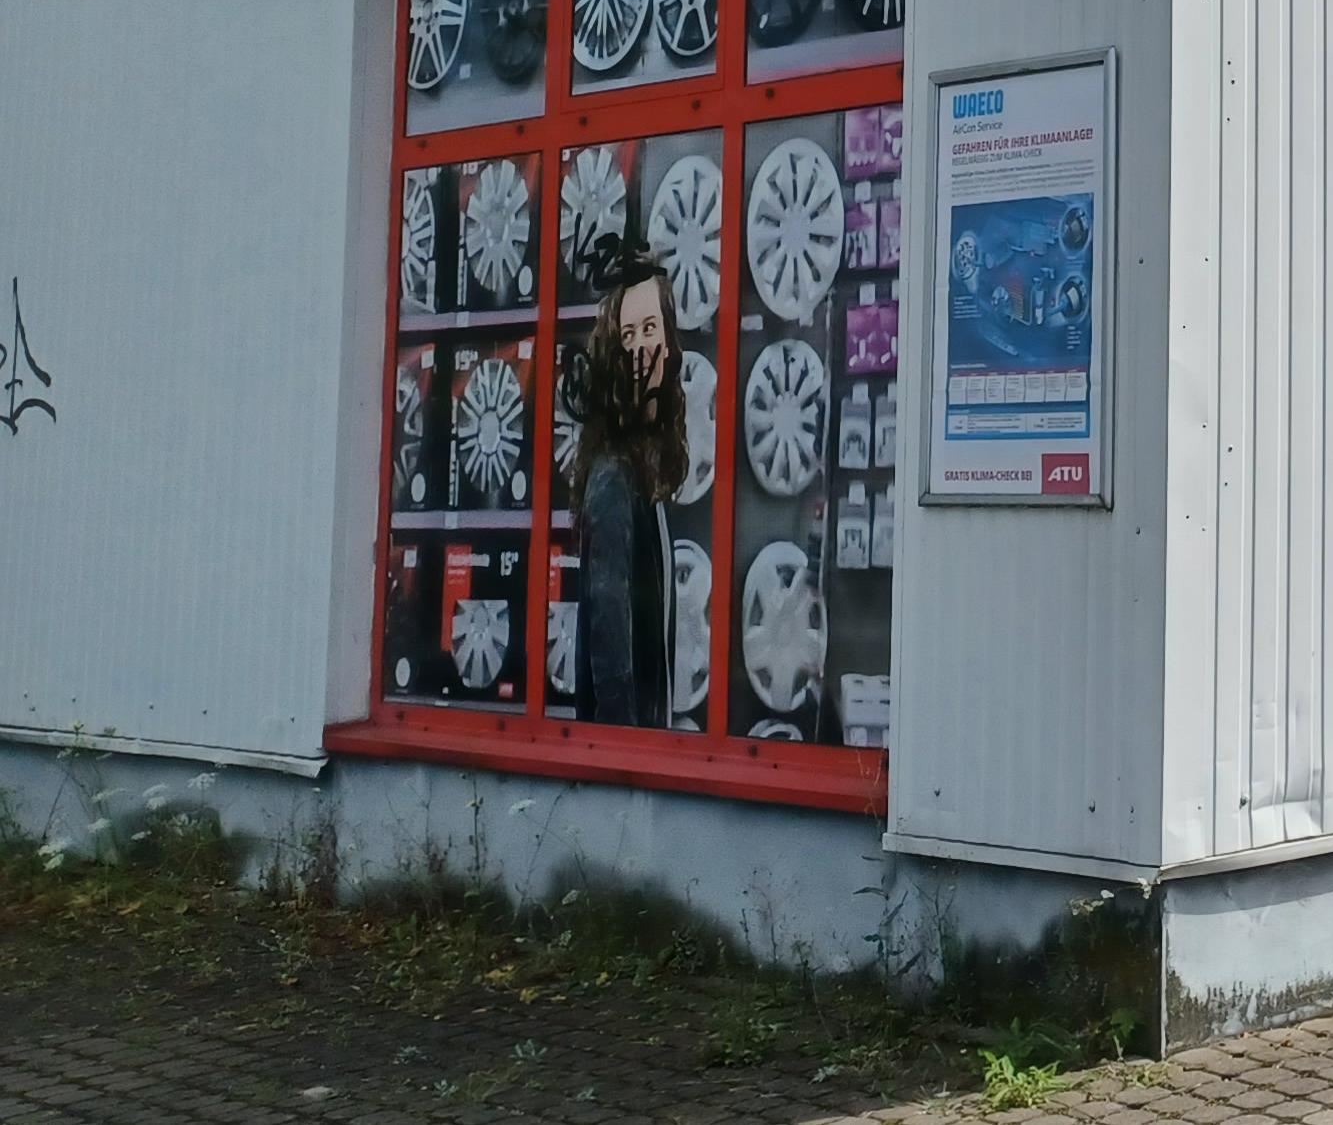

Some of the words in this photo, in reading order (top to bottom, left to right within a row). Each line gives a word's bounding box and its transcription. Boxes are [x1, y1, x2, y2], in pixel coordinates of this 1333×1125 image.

[953, 89, 1004, 119] WAECO
[977, 121, 1003, 132] Service
[952, 140, 992, 155] GEFAHREN
[993, 136, 1010, 150] FÜR
[1010, 135, 1029, 148] IHRE
[1030, 128, 1094, 145] KLIMAANLAGE!
[944, 470, 970, 481] GRATIS
[971, 470, 1020, 481] KLIMA-CHECK
[1020, 470, 1033, 481] BEI
[1047, 466, 1083, 482] ATU
